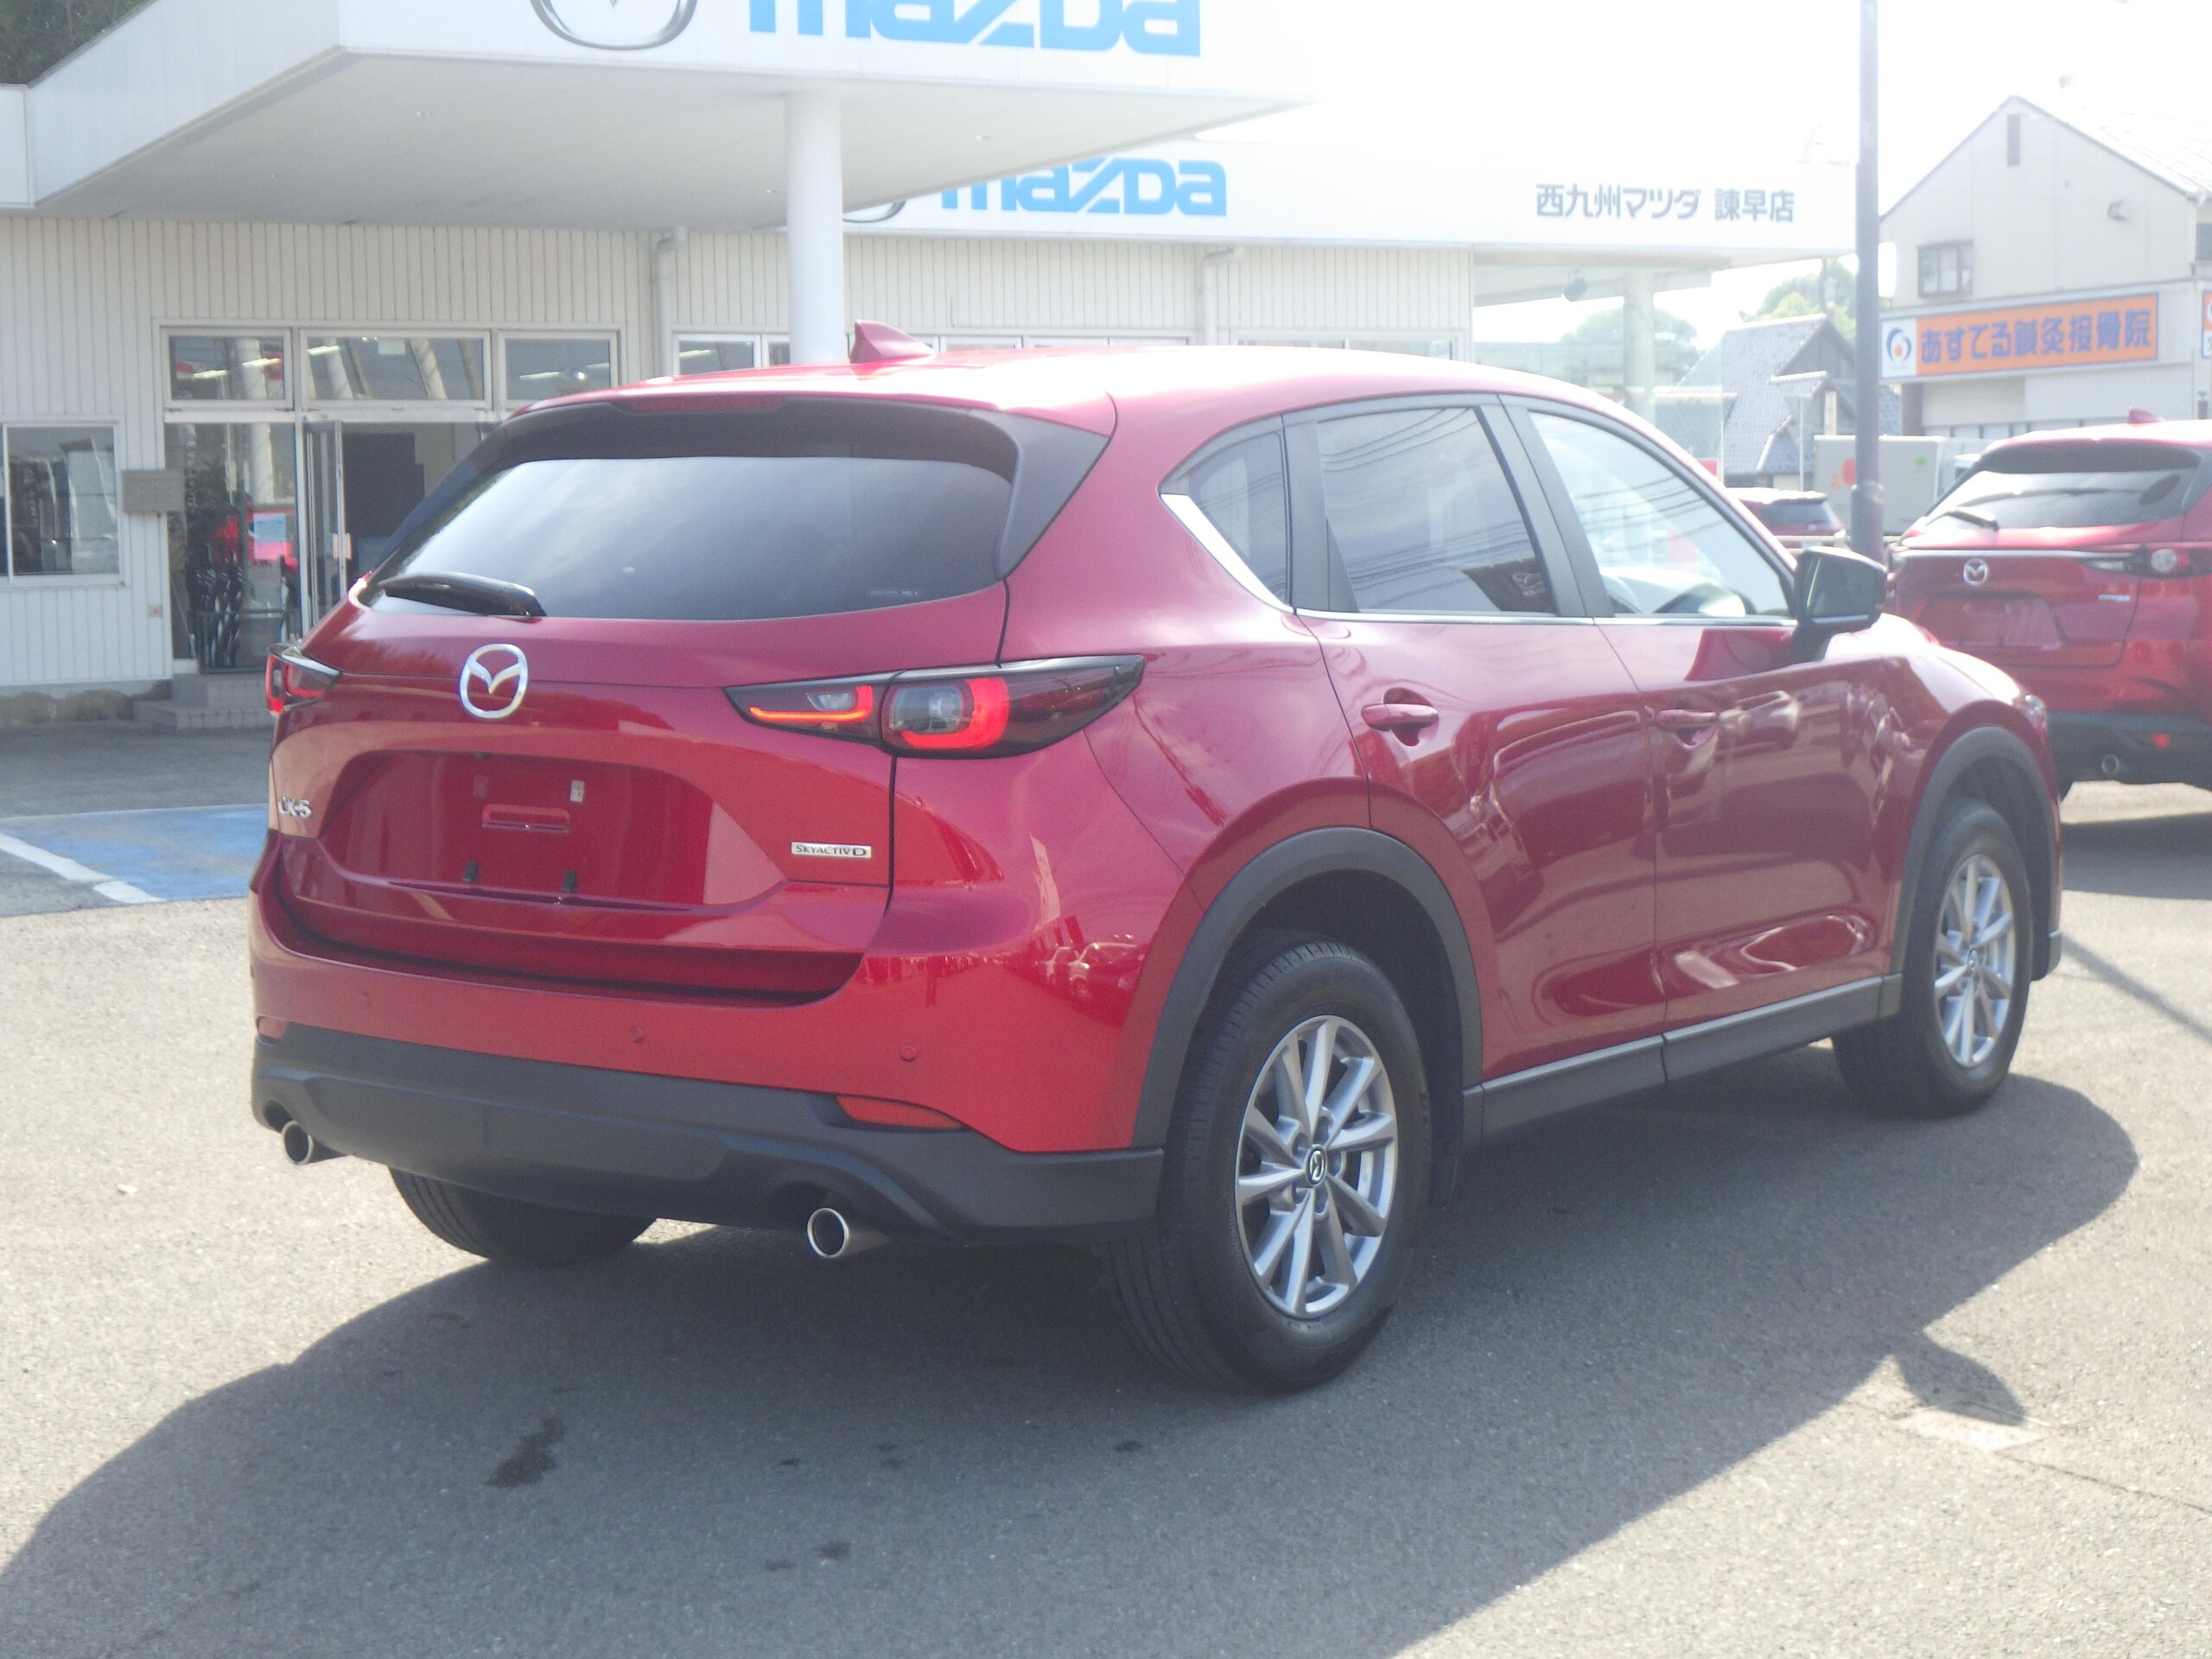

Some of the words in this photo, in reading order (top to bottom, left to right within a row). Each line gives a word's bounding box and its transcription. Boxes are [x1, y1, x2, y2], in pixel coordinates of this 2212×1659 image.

[1535, 183, 1701, 219] 西九州マツダ
